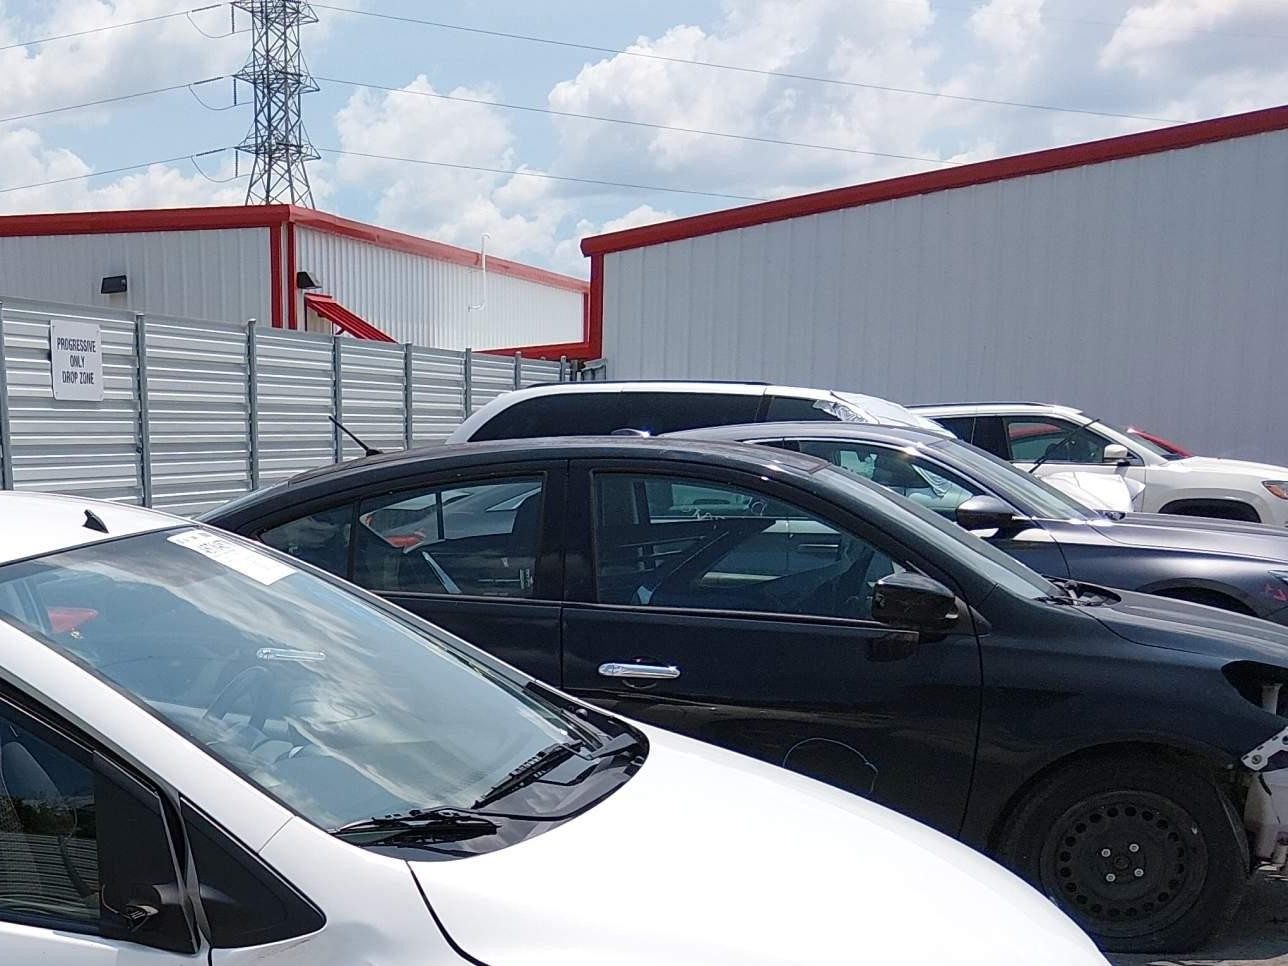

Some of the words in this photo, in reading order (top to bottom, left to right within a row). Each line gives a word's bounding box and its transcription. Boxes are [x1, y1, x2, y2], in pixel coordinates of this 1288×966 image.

[57, 338, 96, 352] PROGRESSIVE
[70, 355, 85, 368] ONLY
[63, 371, 78, 384] DROP
[80, 372, 94, 384] ZONE
